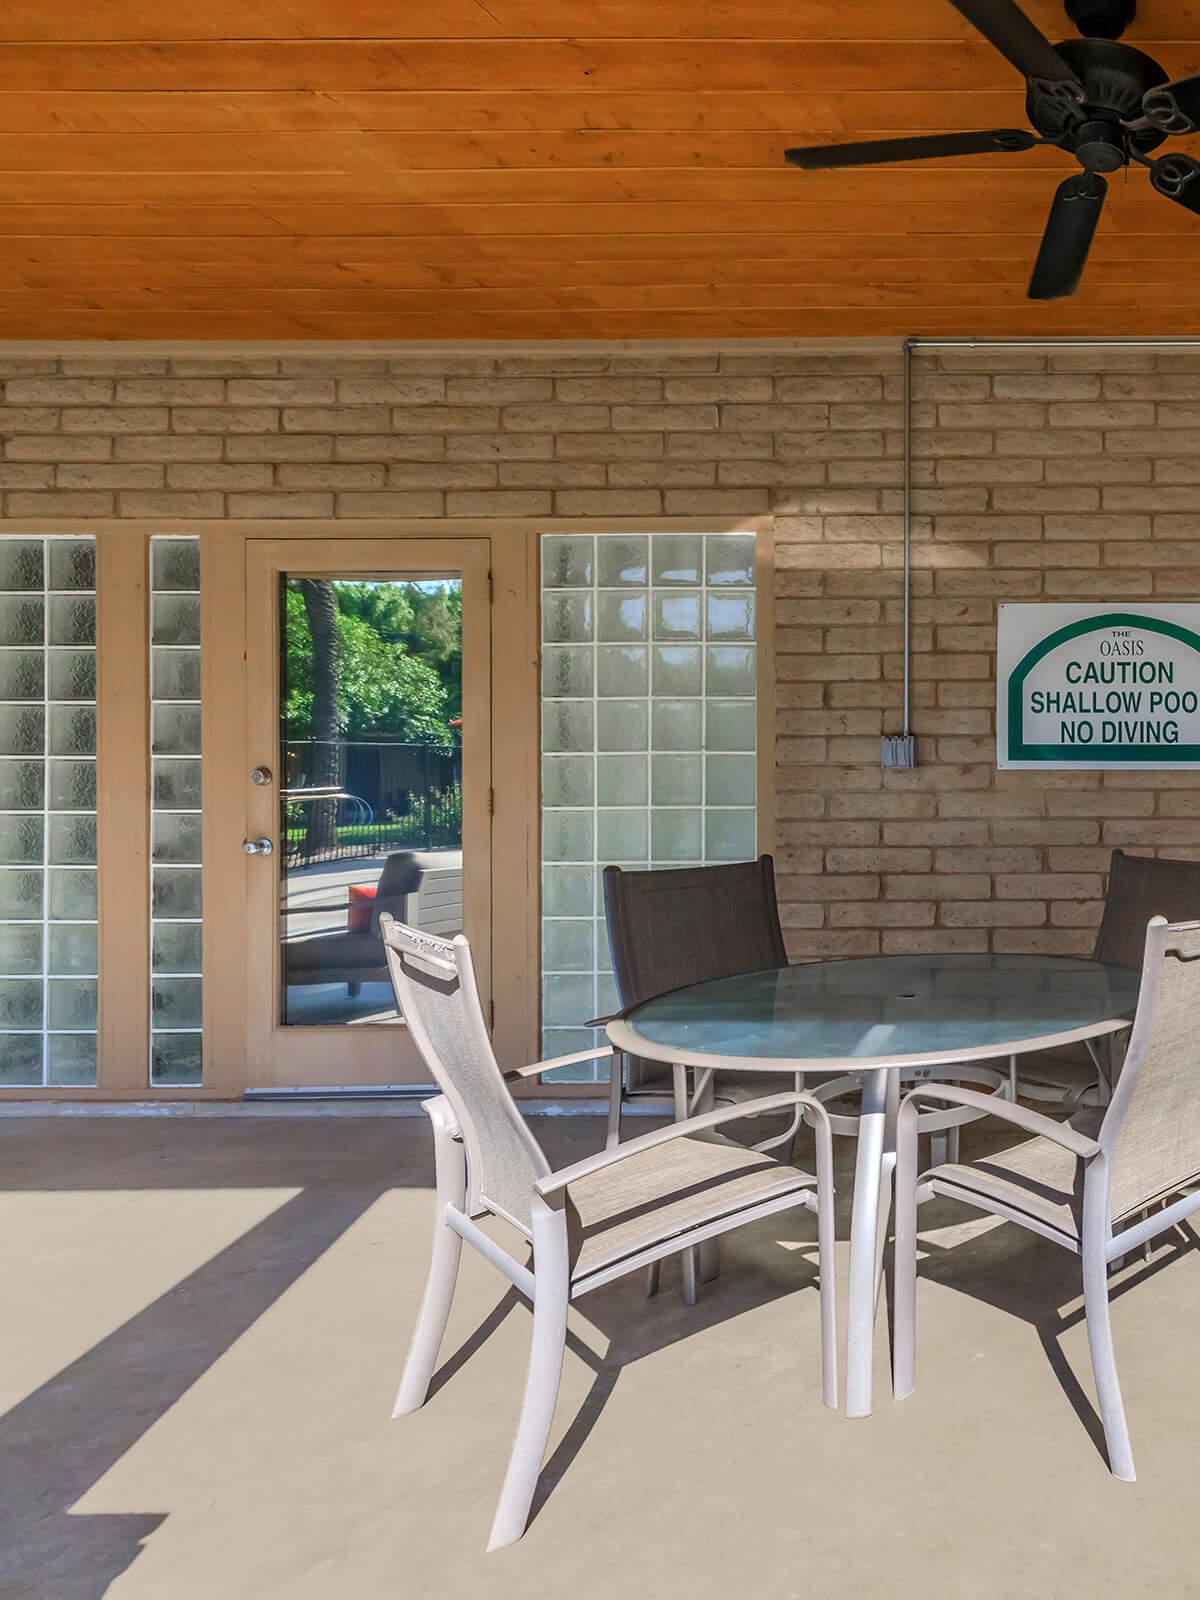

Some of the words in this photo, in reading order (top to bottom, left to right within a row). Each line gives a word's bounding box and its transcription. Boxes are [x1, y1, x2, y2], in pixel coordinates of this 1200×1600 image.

[1100, 640, 1144, 657] OASIS
[1066, 661, 1174, 684] CAUTION
[1030, 691, 1142, 714] SHALLOW
[1060, 720, 1093, 743] NO
[1101, 720, 1179, 743] DIVING
